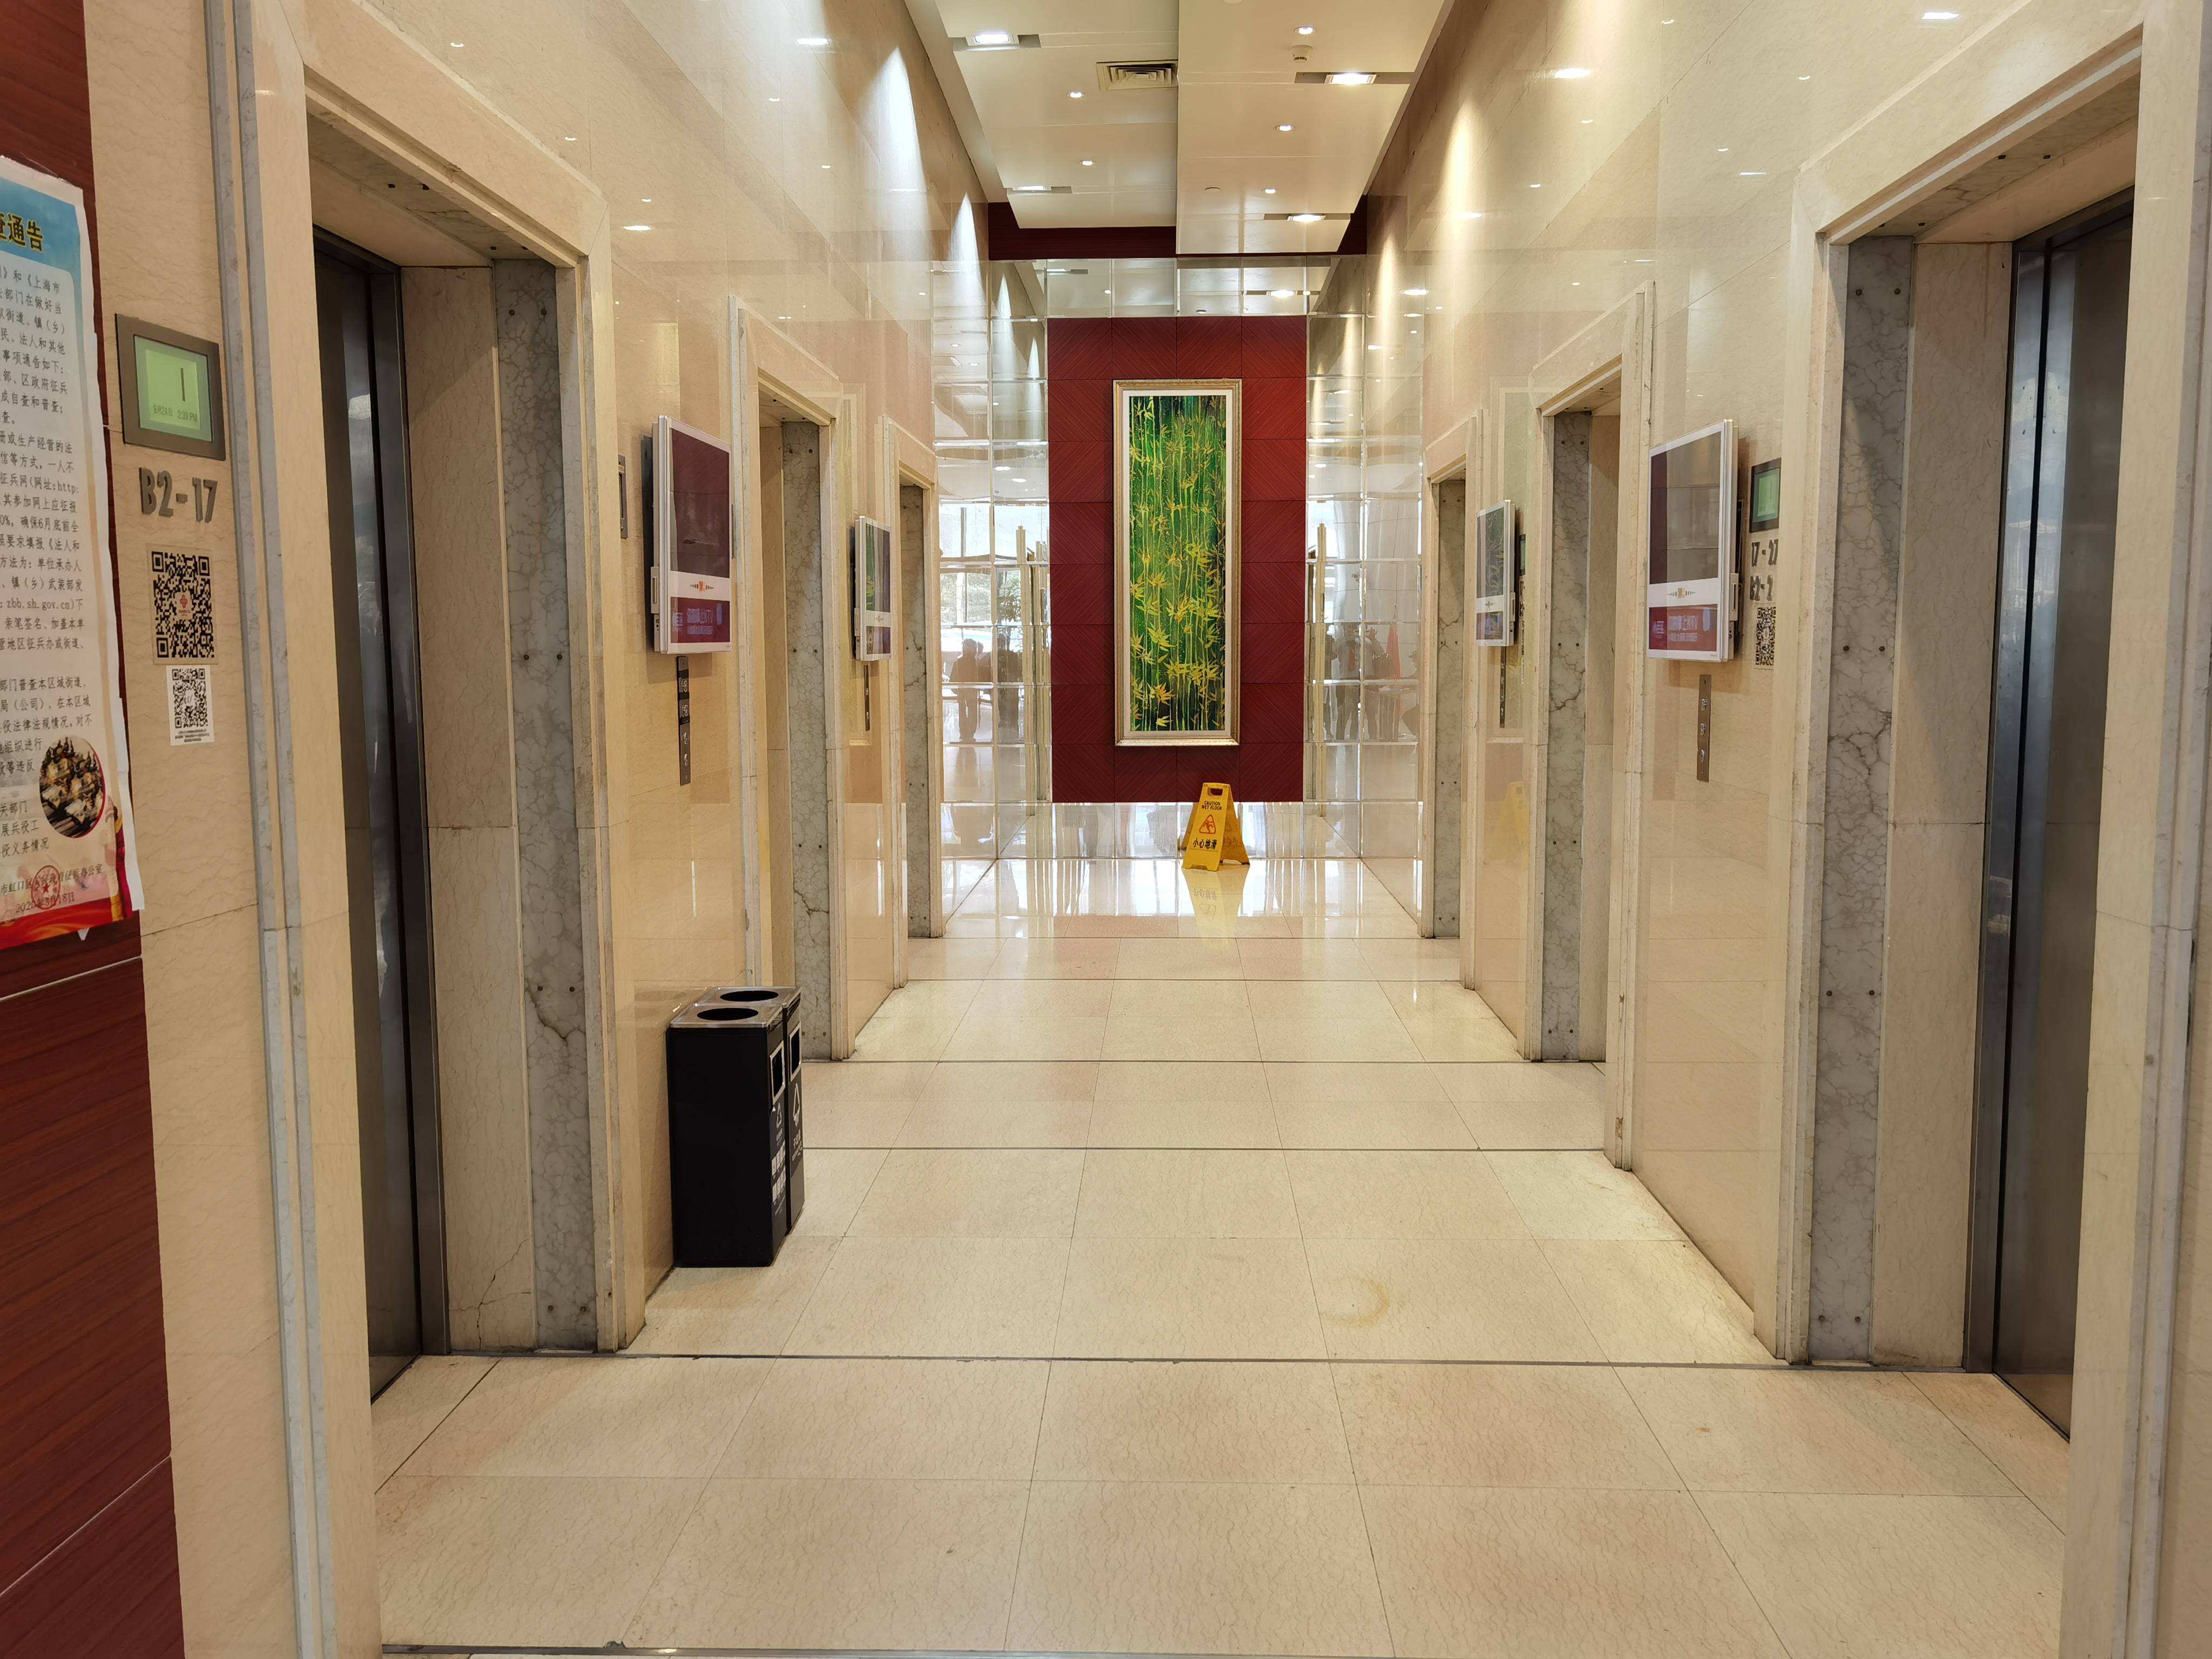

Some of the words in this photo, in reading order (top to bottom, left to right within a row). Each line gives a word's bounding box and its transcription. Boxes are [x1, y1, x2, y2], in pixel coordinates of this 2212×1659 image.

[0, 265, 60, 294] 》和《上海市
[0, 287, 61, 314] 部门在做好当
[139, 467, 218, 523] B2-17
[0, 713, 92, 733] 役法律法规情况。对不
[1193, 838, 1217, 850] 小心地滑
